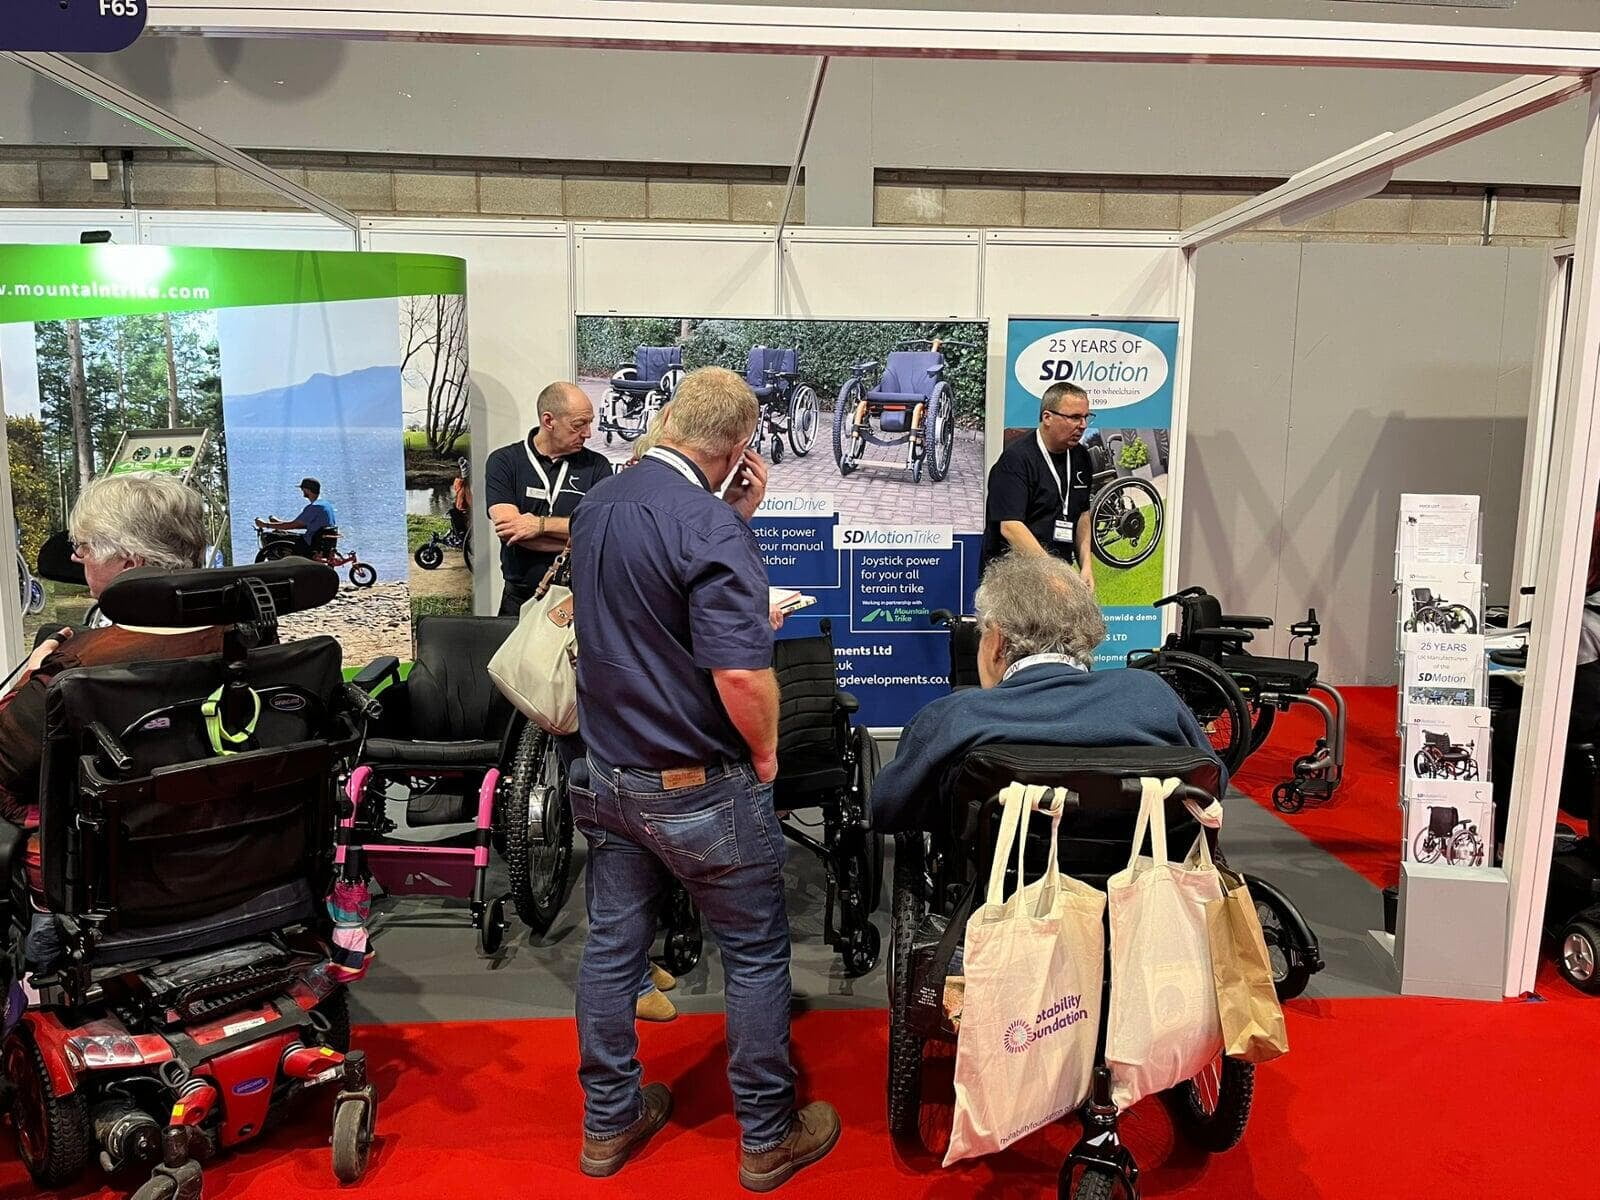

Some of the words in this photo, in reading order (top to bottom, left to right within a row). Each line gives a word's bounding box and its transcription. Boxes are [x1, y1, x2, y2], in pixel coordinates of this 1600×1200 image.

[100, 0, 138, 16] F65
[1049, 339, 1066, 353] 25
[1072, 339, 1117, 354] YEARS
[1122, 340, 1142, 354] OF
[1039, 359, 1148, 382] SDMotion
[1102, 387, 1140, 395] wheelchairs
[782, 528, 816, 540] power
[843, 529, 941, 544] SDMotionTrike
[758, 543, 779, 551] our
[781, 540, 825, 551] manual
[861, 555, 903, 568] Joystick
[906, 557, 940, 568] power
[861, 569, 876, 580] for
[878, 571, 904, 582] your
[905, 569, 920, 580] all
[861, 583, 897, 593] terrain
[900, 583, 924, 593] trike
[894, 607, 930, 615] Mountain
[1136, 613, 1157, 621] demo
[873, 645, 892, 656] Ltd
[1420, 642, 1432, 651] 25
[1434, 643, 1467, 652] YEARS
[1418, 672, 1466, 683] SDMotion
